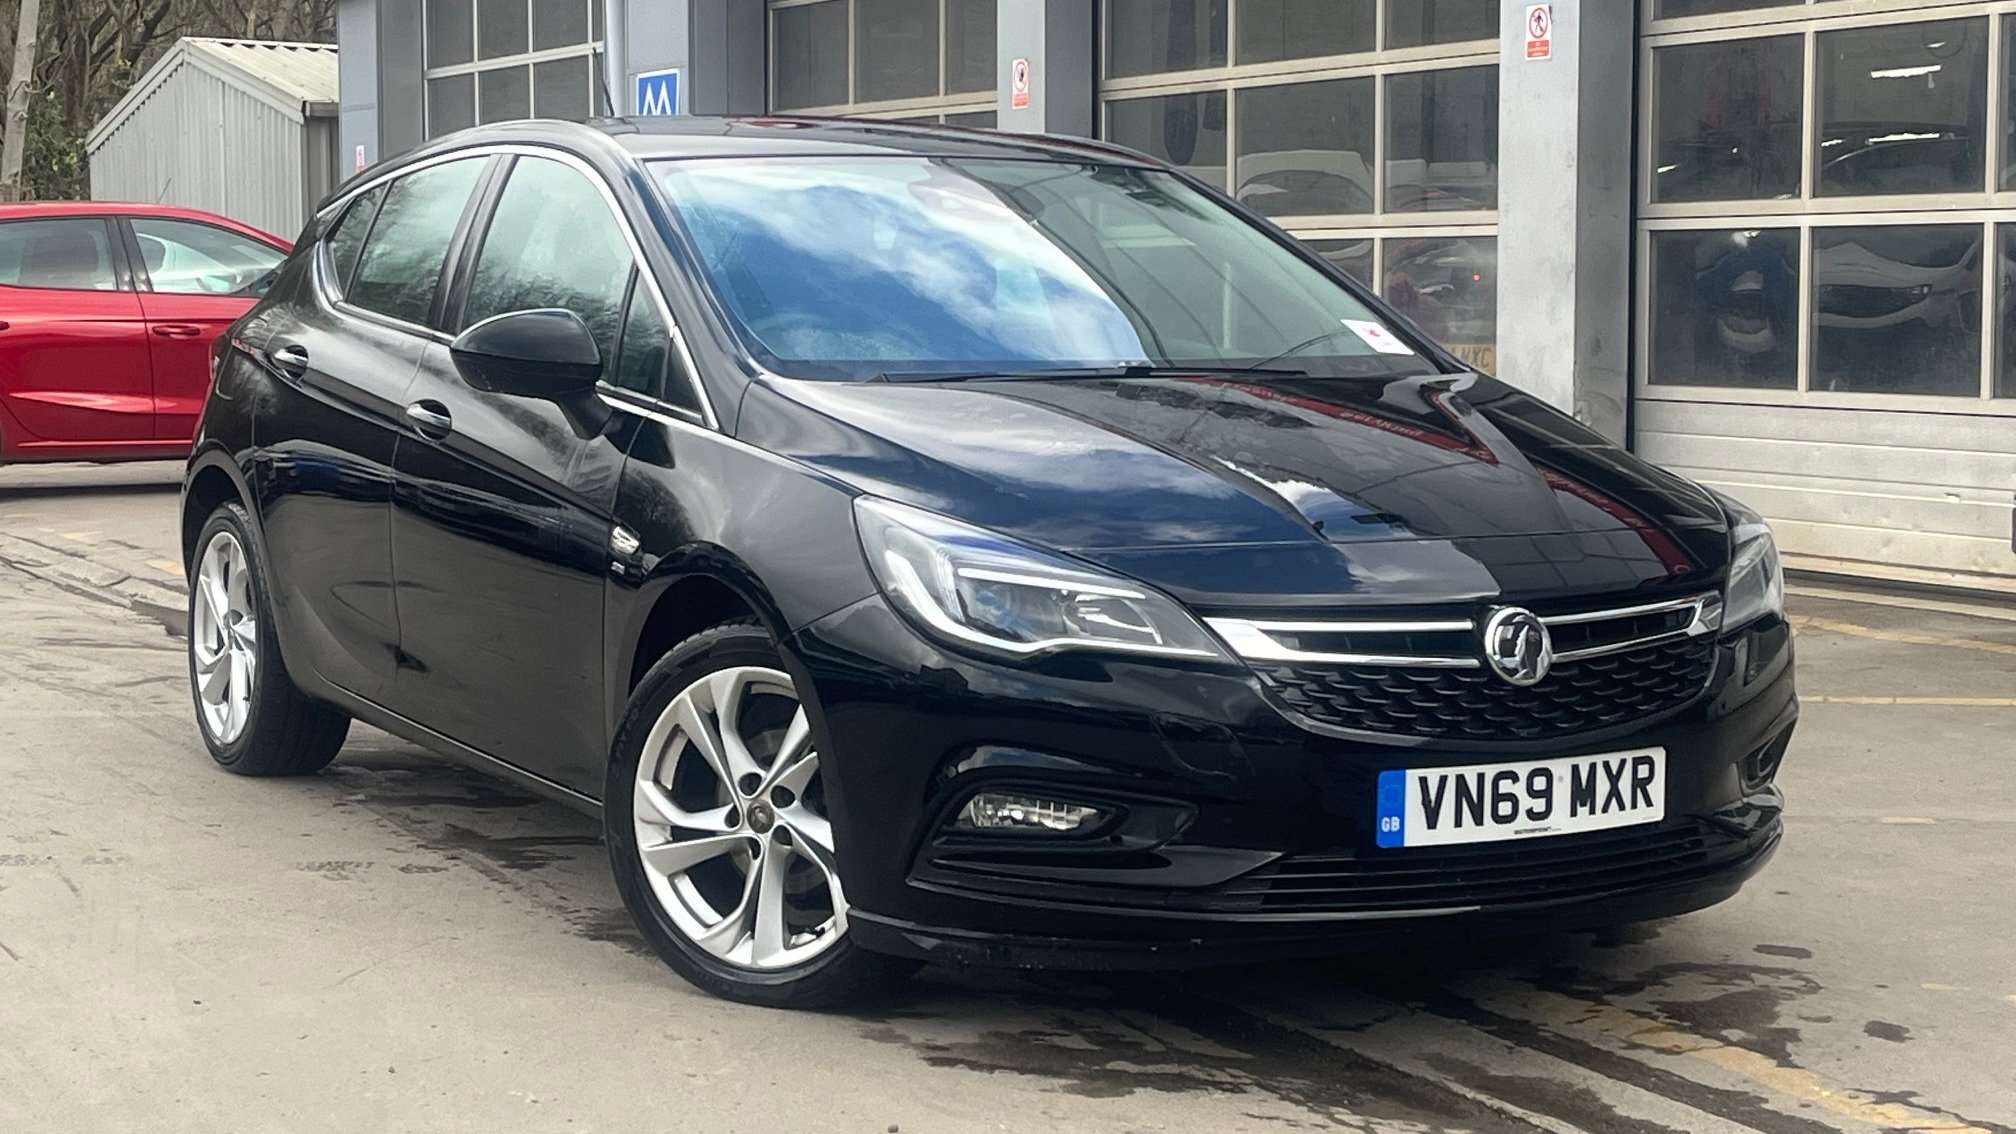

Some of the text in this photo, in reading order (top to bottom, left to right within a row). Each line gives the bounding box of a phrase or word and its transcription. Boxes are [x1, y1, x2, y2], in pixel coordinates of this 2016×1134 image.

[1418, 755, 1655, 830] VN69 MXR
[1381, 816, 1401, 832] GB
